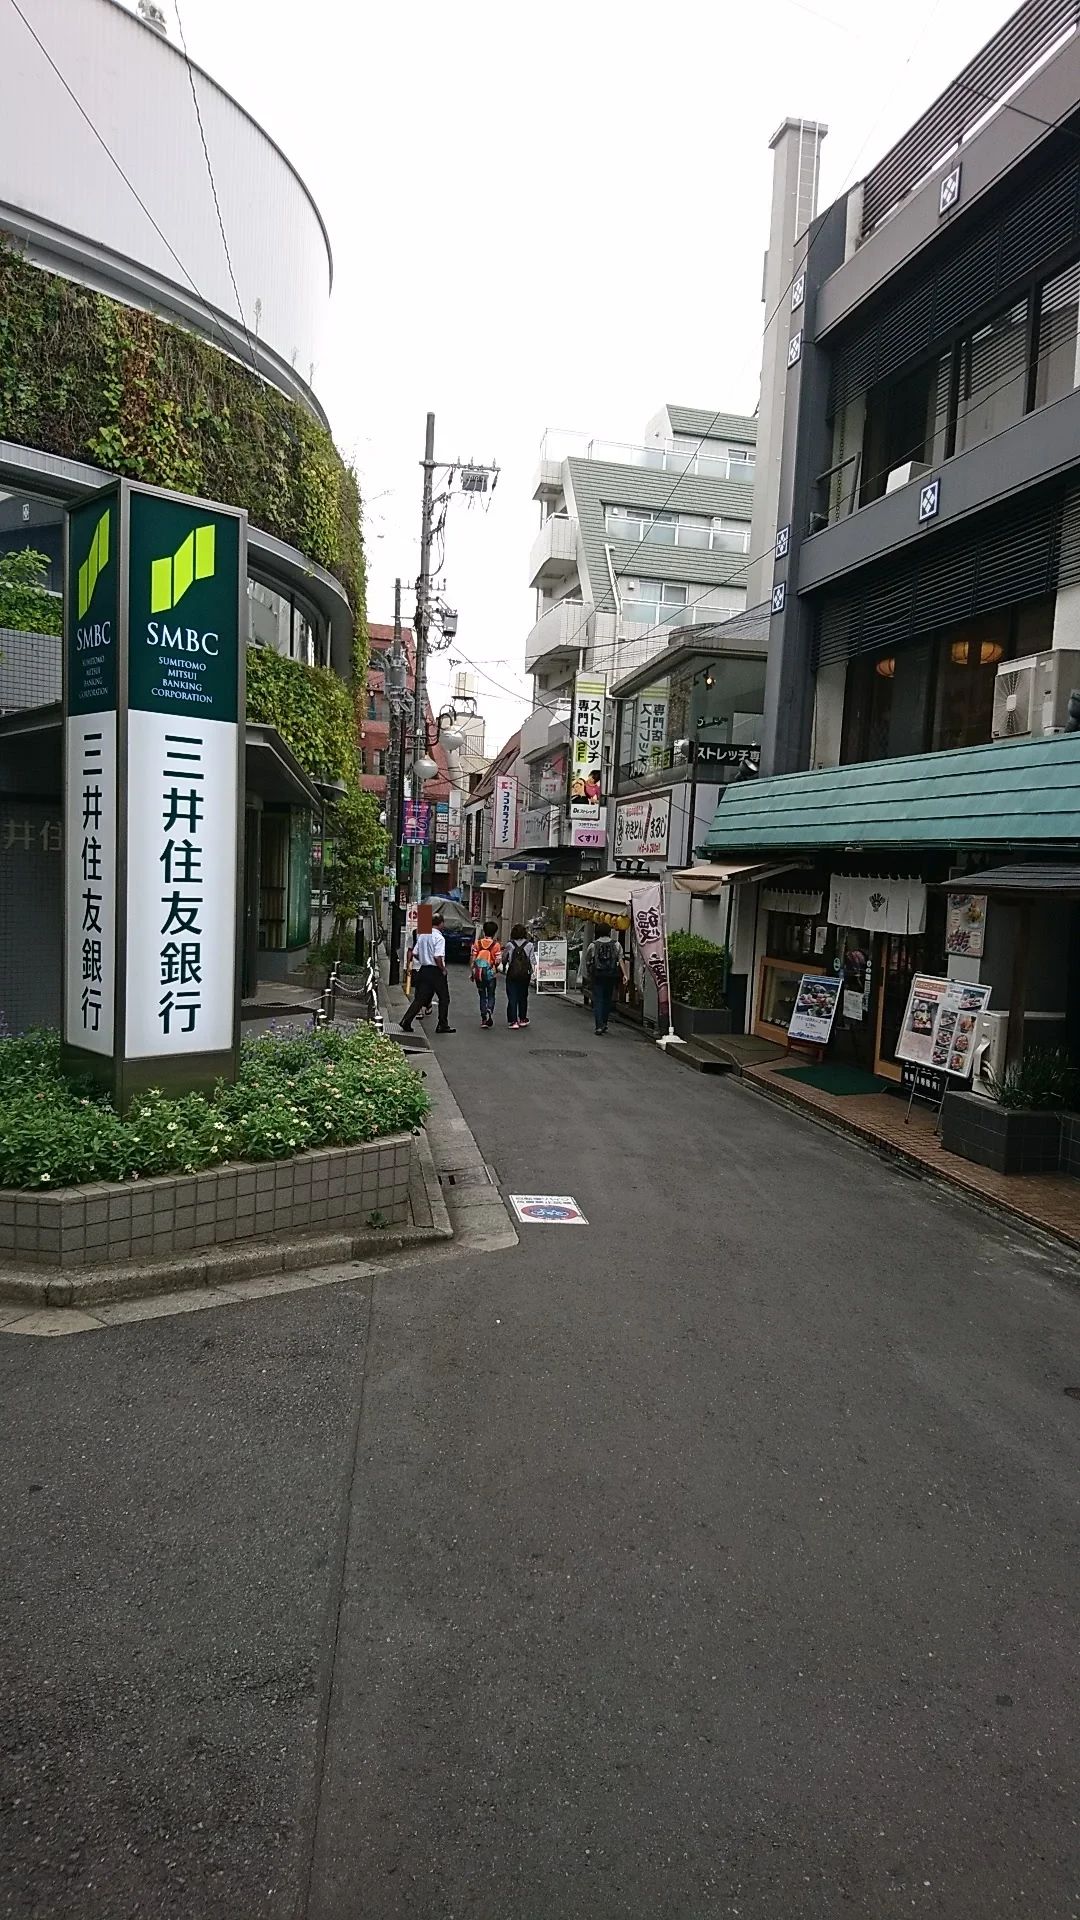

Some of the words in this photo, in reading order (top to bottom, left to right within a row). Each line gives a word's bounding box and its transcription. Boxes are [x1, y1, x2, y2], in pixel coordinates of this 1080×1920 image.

[76, 621, 111, 651] SMBC
[146, 621, 219, 656] SMBC
[158, 656, 207, 672] SUMITOMO
[167, 668, 197, 681] MITSUI
[151, 687, 213, 704] CORPORATION
[162, 678, 203, 692] BANKING
[576, 699, 590, 738] 専門店
[587, 699, 602, 764] ストレッチ
[577, 741, 586, 762] 2F
[501, 791, 510, 843] ココカラファイン
[577, 834, 599, 844] くすり
[81, 732, 103, 1032] 三井住友銀行
[158, 734, 205, 1035] 三井住友銀行
